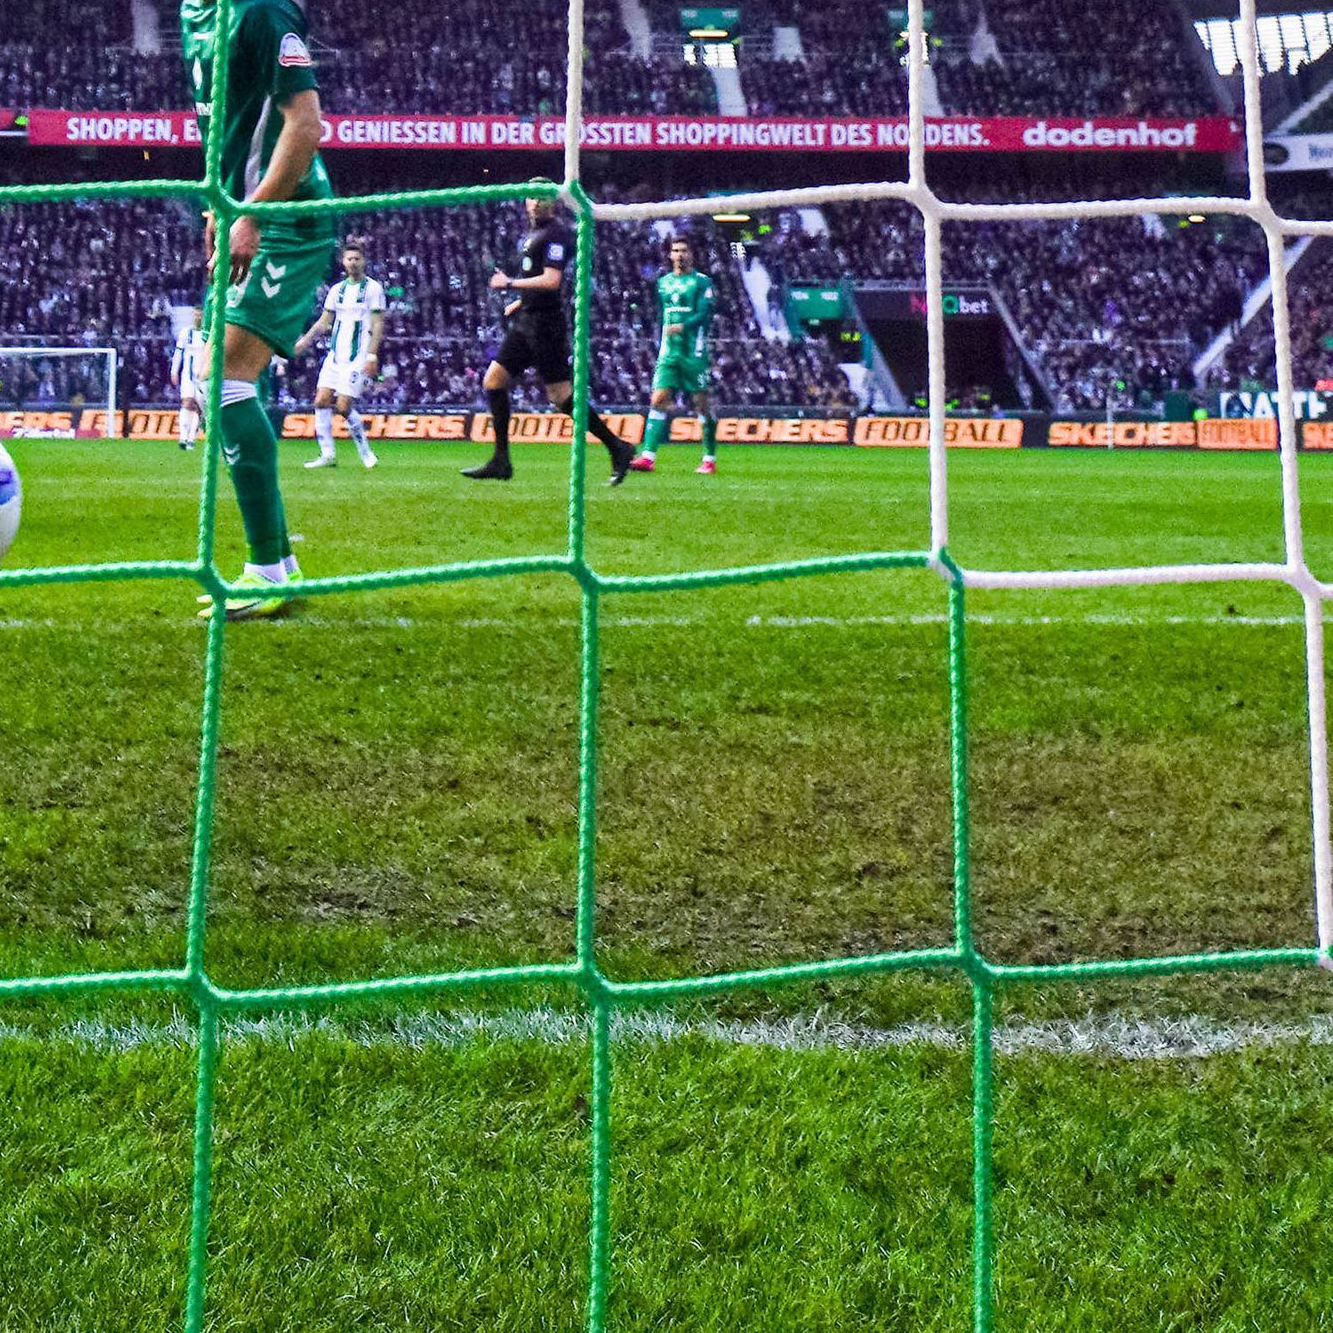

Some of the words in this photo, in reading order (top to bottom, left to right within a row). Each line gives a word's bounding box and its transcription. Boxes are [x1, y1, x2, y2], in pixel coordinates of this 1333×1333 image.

[66, 118, 179, 144] SHOPPEN,
[337, 120, 456, 144] GENIESSEN
[461, 122, 486, 144] IN
[491, 122, 534, 144] DER
[656, 122, 826, 146] SHOPPINGWELT
[833, 123, 873, 145] DES
[877, 123, 991, 146] NODENS.
[1022, 122, 1196, 147] dodenhof
[864, 421, 1009, 442] FOOBALL
